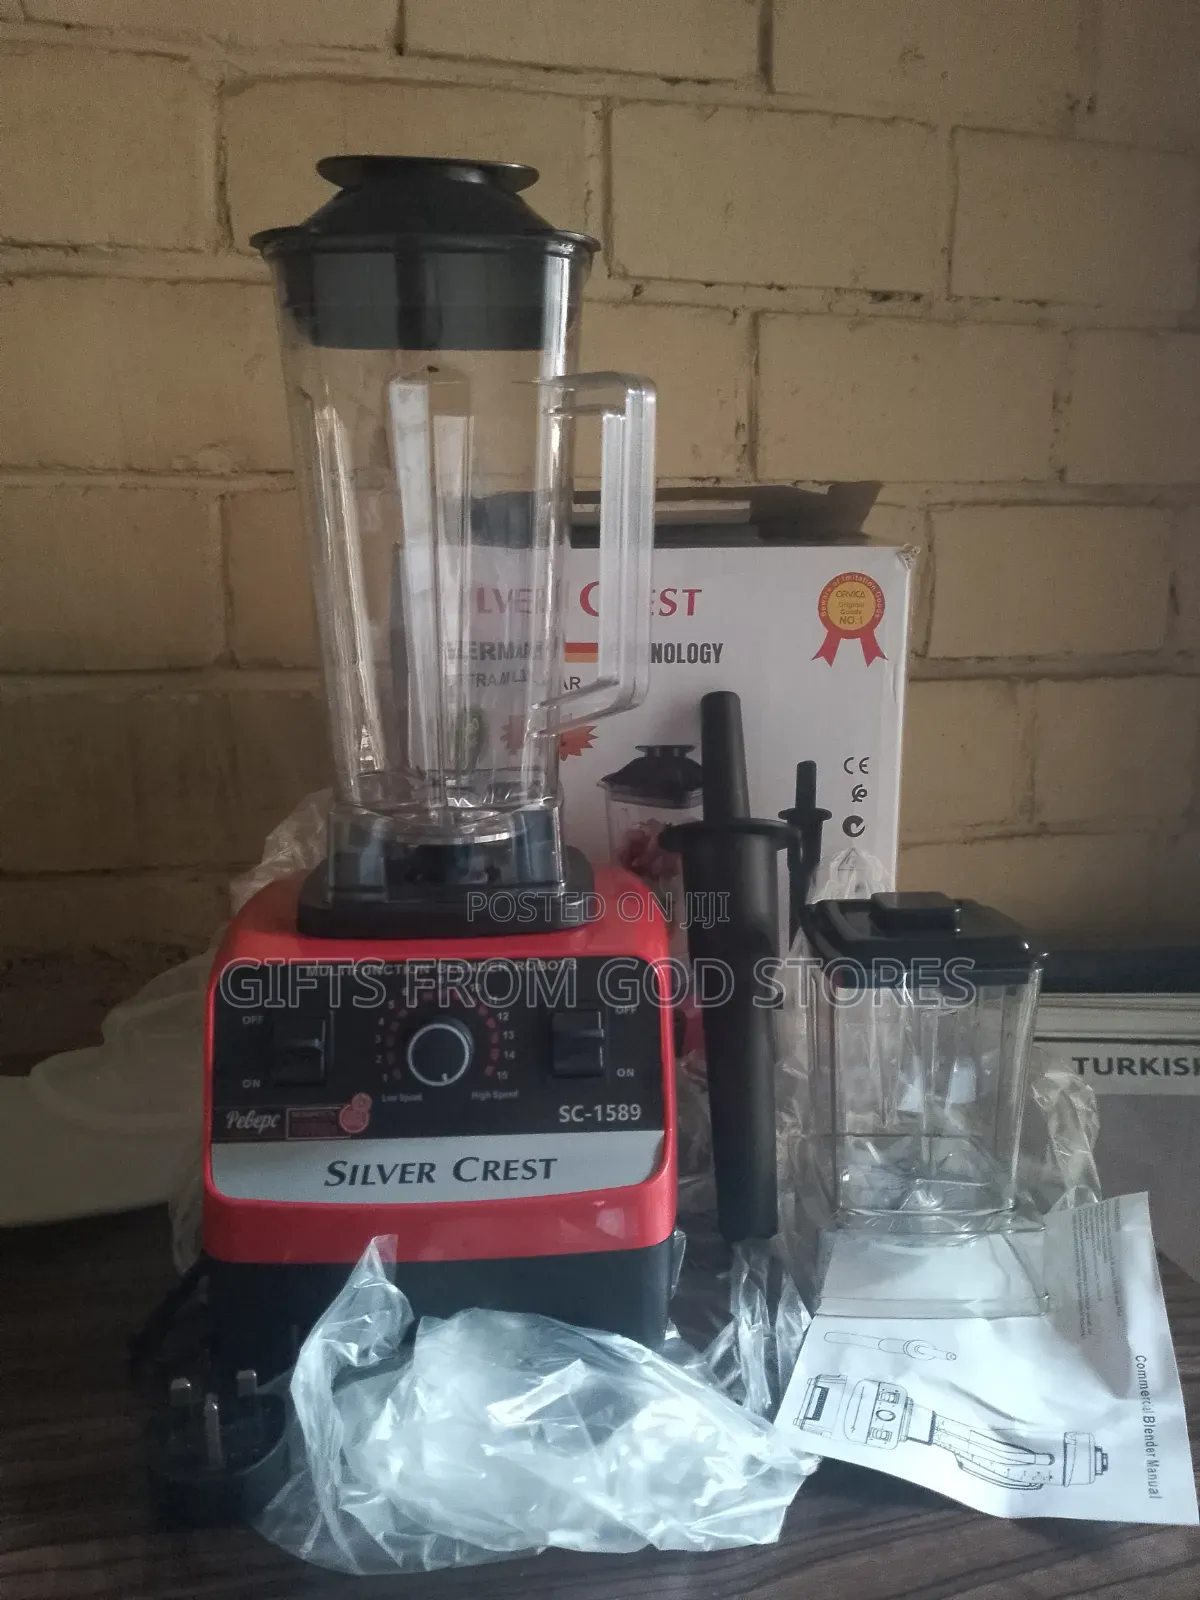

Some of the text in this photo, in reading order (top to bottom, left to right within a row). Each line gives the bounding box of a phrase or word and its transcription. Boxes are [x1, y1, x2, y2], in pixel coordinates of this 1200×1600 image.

[836, 590, 866, 598] ORVICA
[651, 643, 723, 664] NOLOGY
[437, 961, 508, 973] BLENDER
[515, 959, 577, 971] ROBOTS
[616, 1006, 636, 1015] OFF
[242, 1016, 263, 1025] OFF
[498, 1012, 509, 1021] 12
[378, 1017, 384, 1026] 4
[375, 1035, 381, 1044] 3
[503, 1031, 515, 1040] 13
[375, 1055, 382, 1064] 2
[504, 1051, 515, 1060] 14
[497, 1071, 508, 1080] 15
[616, 1068, 635, 1077] ON
[242, 1079, 261, 1088] ON
[558, 1103, 642, 1123] SC-1589
[324, 1156, 558, 1187] SILVER CREST
[1135, 1354, 1164, 1499] Commercial Blender Manual
